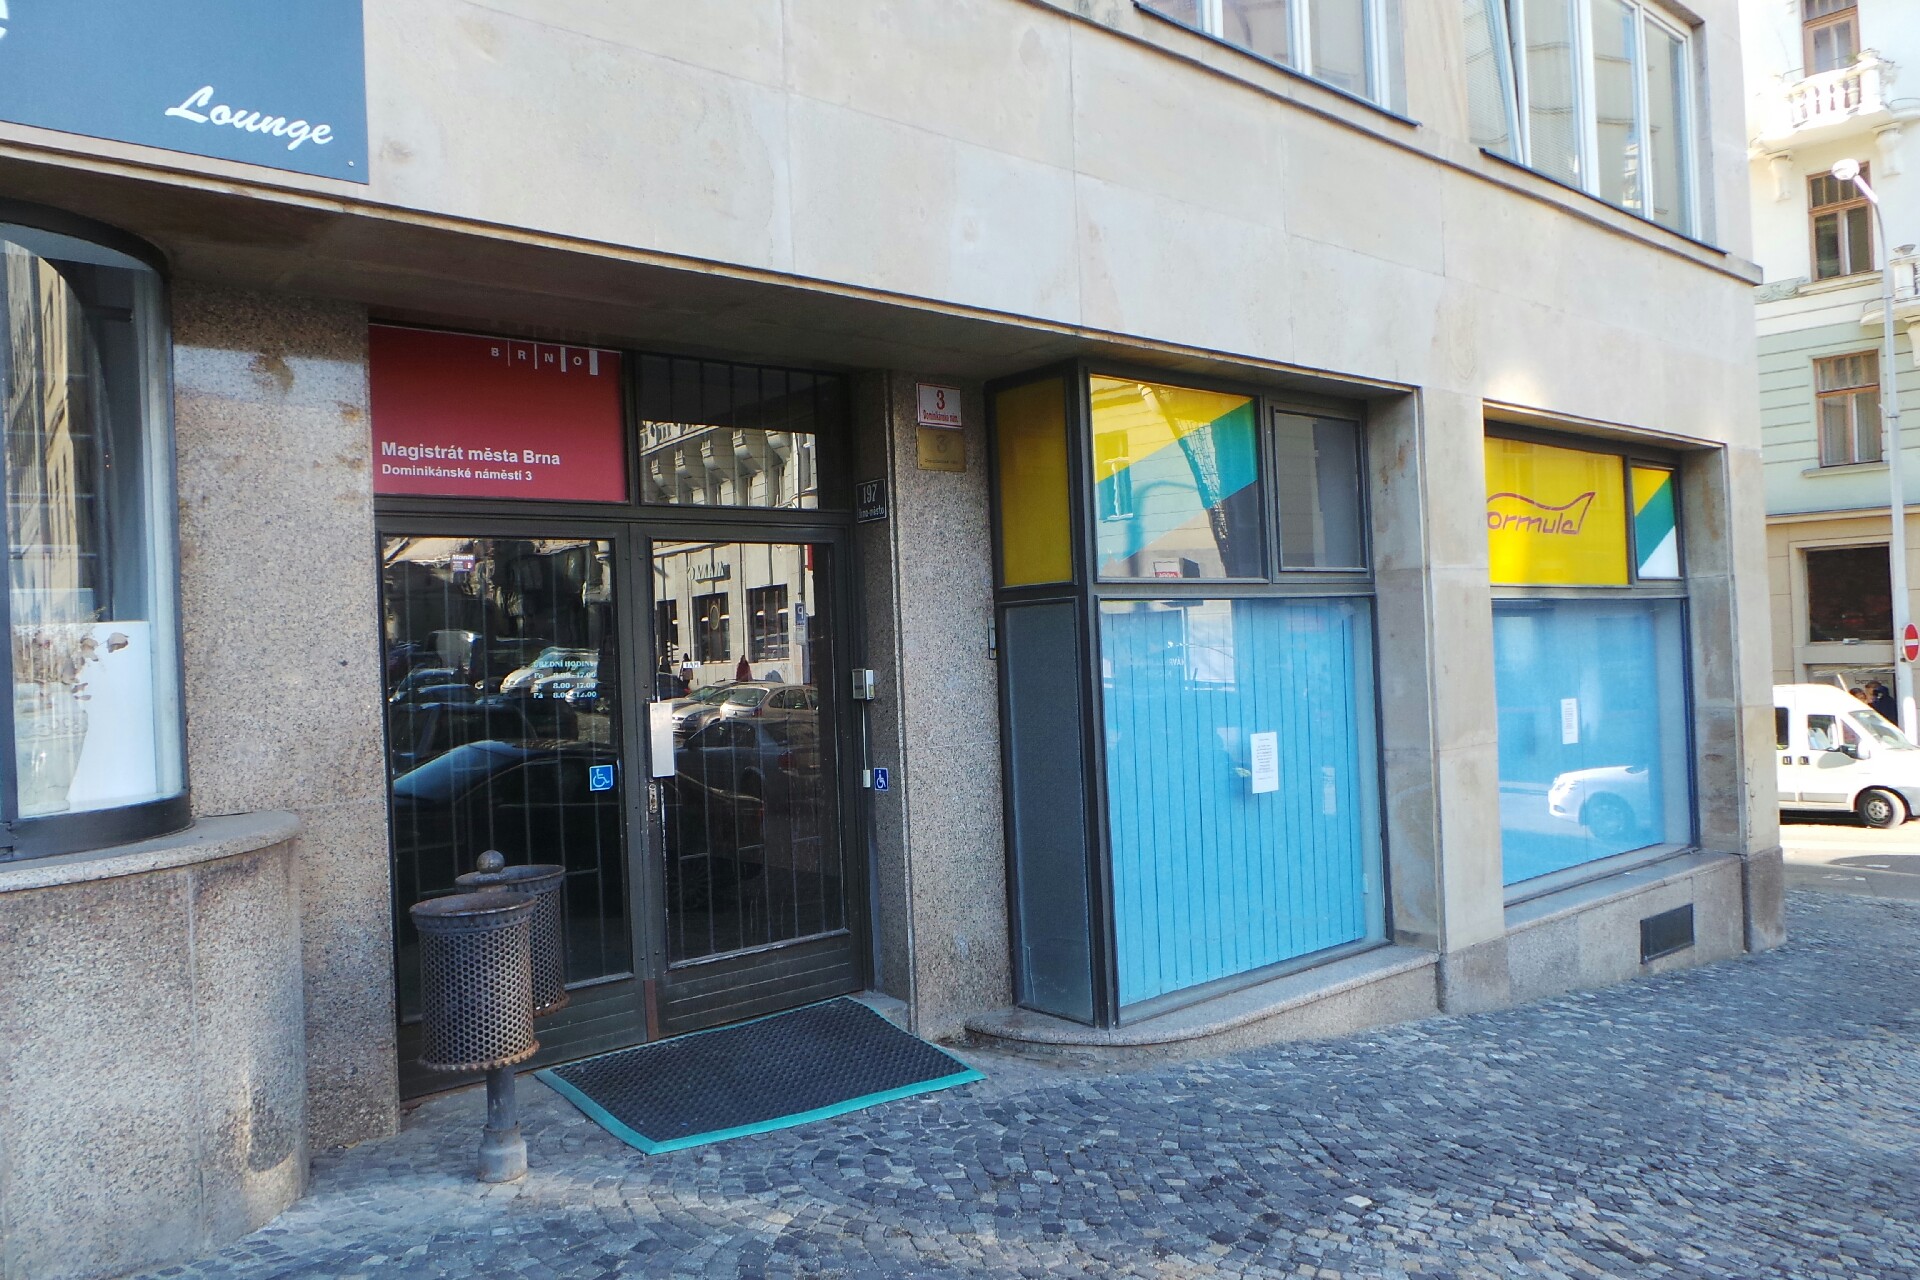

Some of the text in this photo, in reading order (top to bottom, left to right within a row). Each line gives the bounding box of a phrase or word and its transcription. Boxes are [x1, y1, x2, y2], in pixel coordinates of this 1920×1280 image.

[164, 85, 333, 151] Lounge
[936, 390, 945, 410] 3
[381, 441, 561, 465] Magistrát města Brna
[381, 463, 533, 481] Dominikánské náměstí 3
[863, 483, 877, 503] 197
